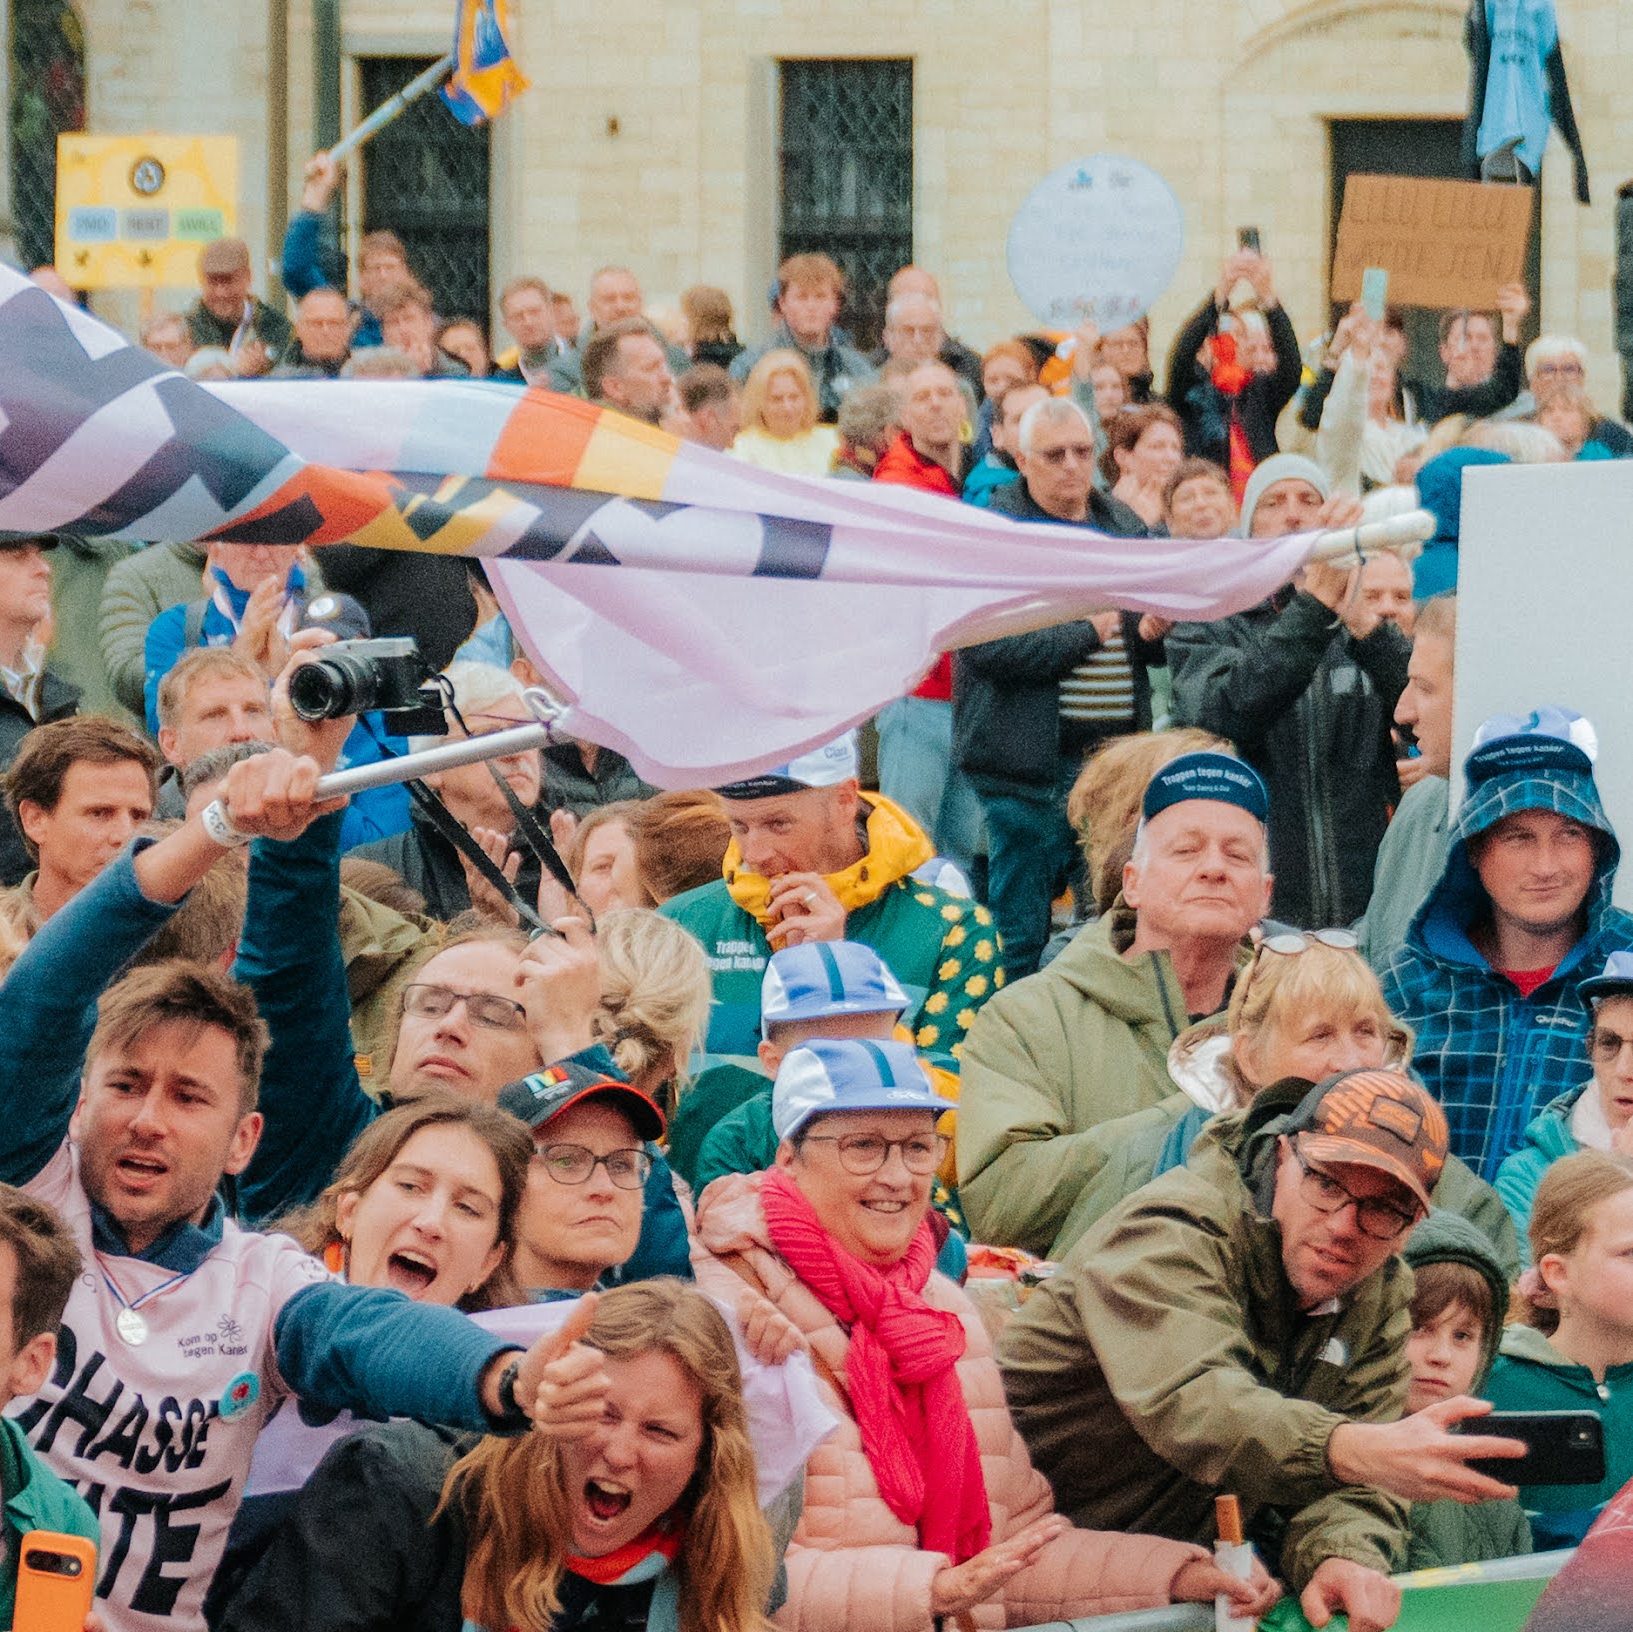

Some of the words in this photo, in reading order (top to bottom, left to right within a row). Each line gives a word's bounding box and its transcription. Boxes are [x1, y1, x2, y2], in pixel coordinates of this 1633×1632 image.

[1161, 769, 1197, 786] Trappen
[1197, 766, 1224, 778] tegen
[1224, 770, 1254, 788] kanker
[705, 957, 732, 970] egen
[178, 1335, 200, 1348] Kom
[203, 1333, 217, 1345] op
[183, 1346, 215, 1358] tegen
